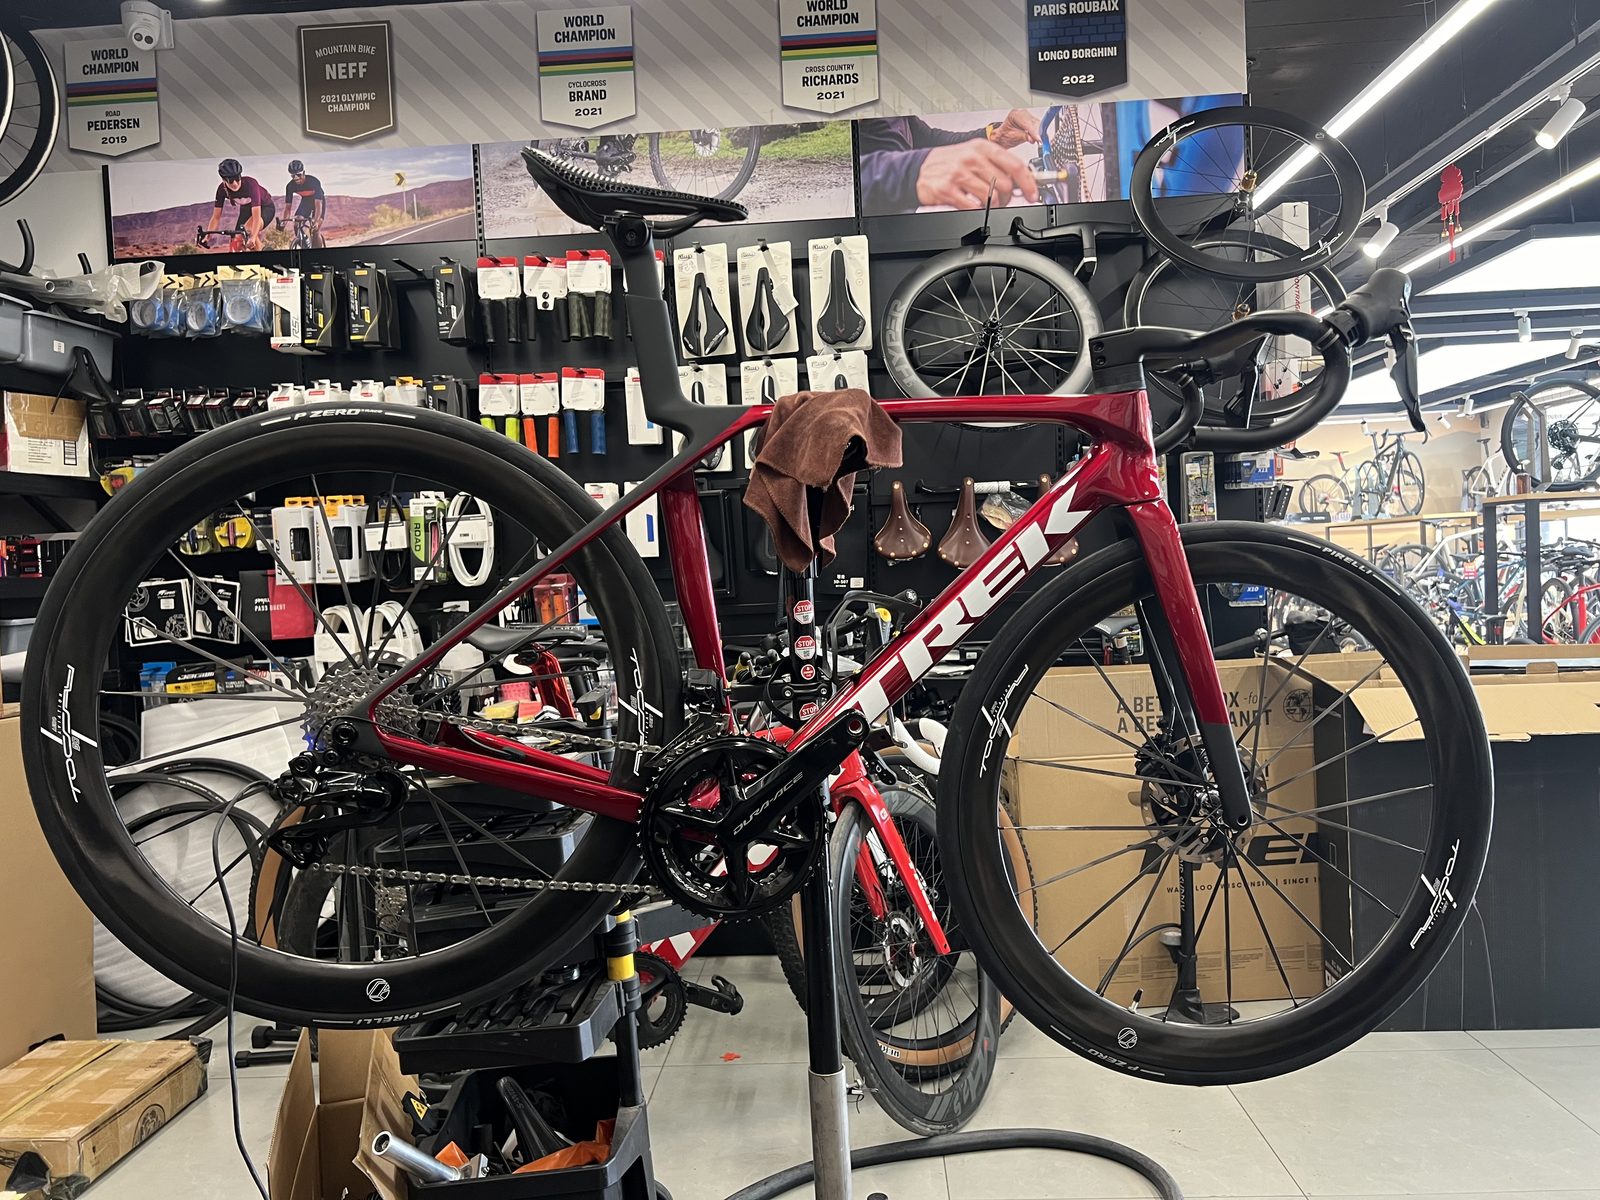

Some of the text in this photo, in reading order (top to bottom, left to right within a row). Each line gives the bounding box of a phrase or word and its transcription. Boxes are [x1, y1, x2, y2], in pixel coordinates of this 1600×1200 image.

[806, 0, 848, 14] WORLD
[1033, 0, 1120, 17] PARIS ROUBAIX
[563, 14, 605, 28] WORLD
[796, 11, 859, 28] CHAMPION
[554, 28, 616, 43] CHAMPION
[91, 48, 129, 61] WORLD
[315, 44, 376, 59] MOUNTAIN BIKE
[1038, 46, 1118, 62] LONGO BORGHINI
[82, 61, 139, 76] CHAMPION
[324, 61, 368, 80] NEFF
[805, 63, 855, 73] CROSS COUNTRY
[568, 79, 607, 89] CYCLOCROSS
[801, 72, 859, 88] RICHARDS
[1062, 74, 1095, 86] 2022
[320, 91, 377, 104] 2021 OLYMPIC
[568, 88, 607, 103] BRAND
[816, 90, 846, 101] 2021
[105, 110, 121, 118] ROAD
[327, 102, 370, 113] CHAMPION
[574, 106, 603, 118] 2021
[87, 118, 140, 132] PEDERSEN
[101, 134, 128, 146] 2019
[294, 412, 307, 421] P
[309, 408, 361, 418] ZERO
[413, 523, 421, 552] ROAD
[1322, 547, 1372, 575] PIRELLI
[834, 480, 1092, 723] TREK
[802, 706, 818, 716] STOP
[1117, 698, 1128, 714] A
[1117, 717, 1128, 733] A
[733, 772, 803, 836] DURA-ACE
[1167, 885, 1212, 893] WALOO
[1283, 877, 1309, 885] SINCE
[356, 1011, 421, 1026] PIRELLI
[1087, 1048, 1127, 1068] ZERO
